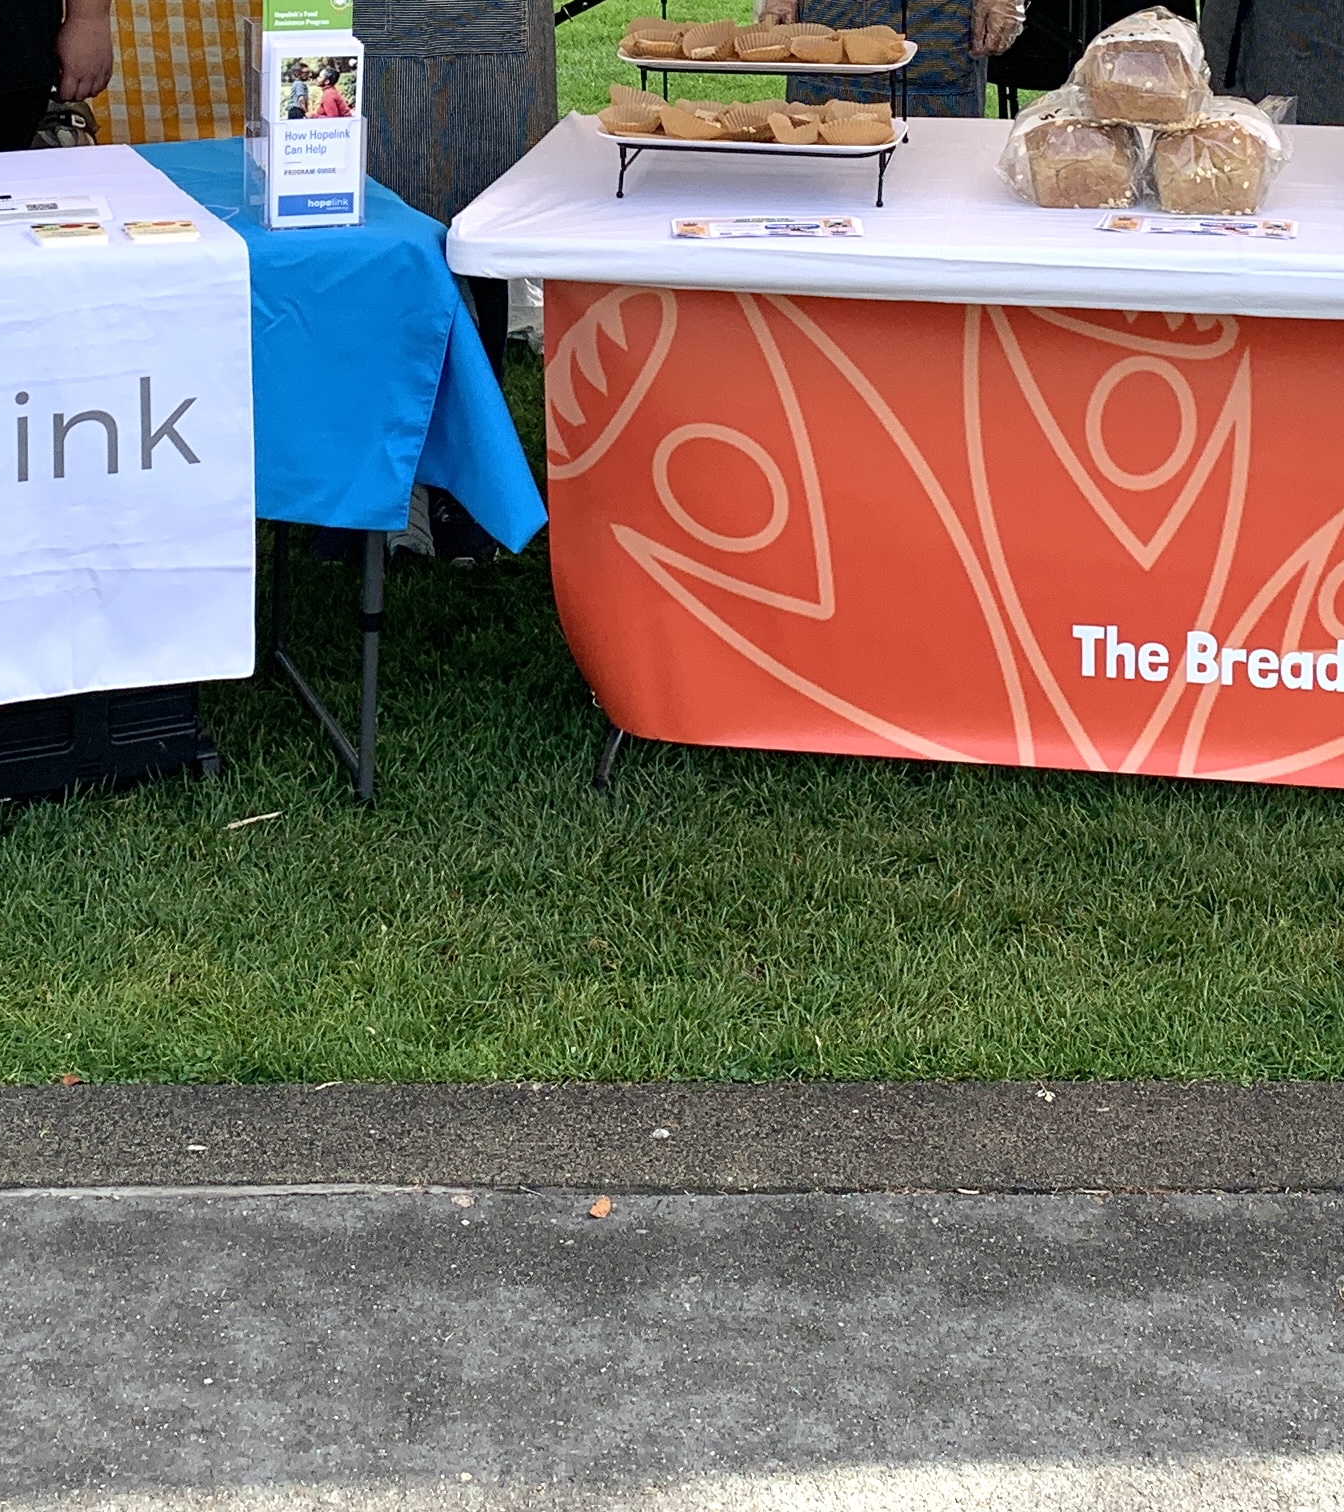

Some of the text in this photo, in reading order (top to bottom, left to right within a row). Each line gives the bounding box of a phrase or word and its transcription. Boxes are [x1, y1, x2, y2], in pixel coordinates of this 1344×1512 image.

[285, 129, 350, 141] How Hopelink
[285, 144, 327, 155] Can Help
[308, 198, 348, 208] hopelink
[1071, 625, 1169, 681] The
